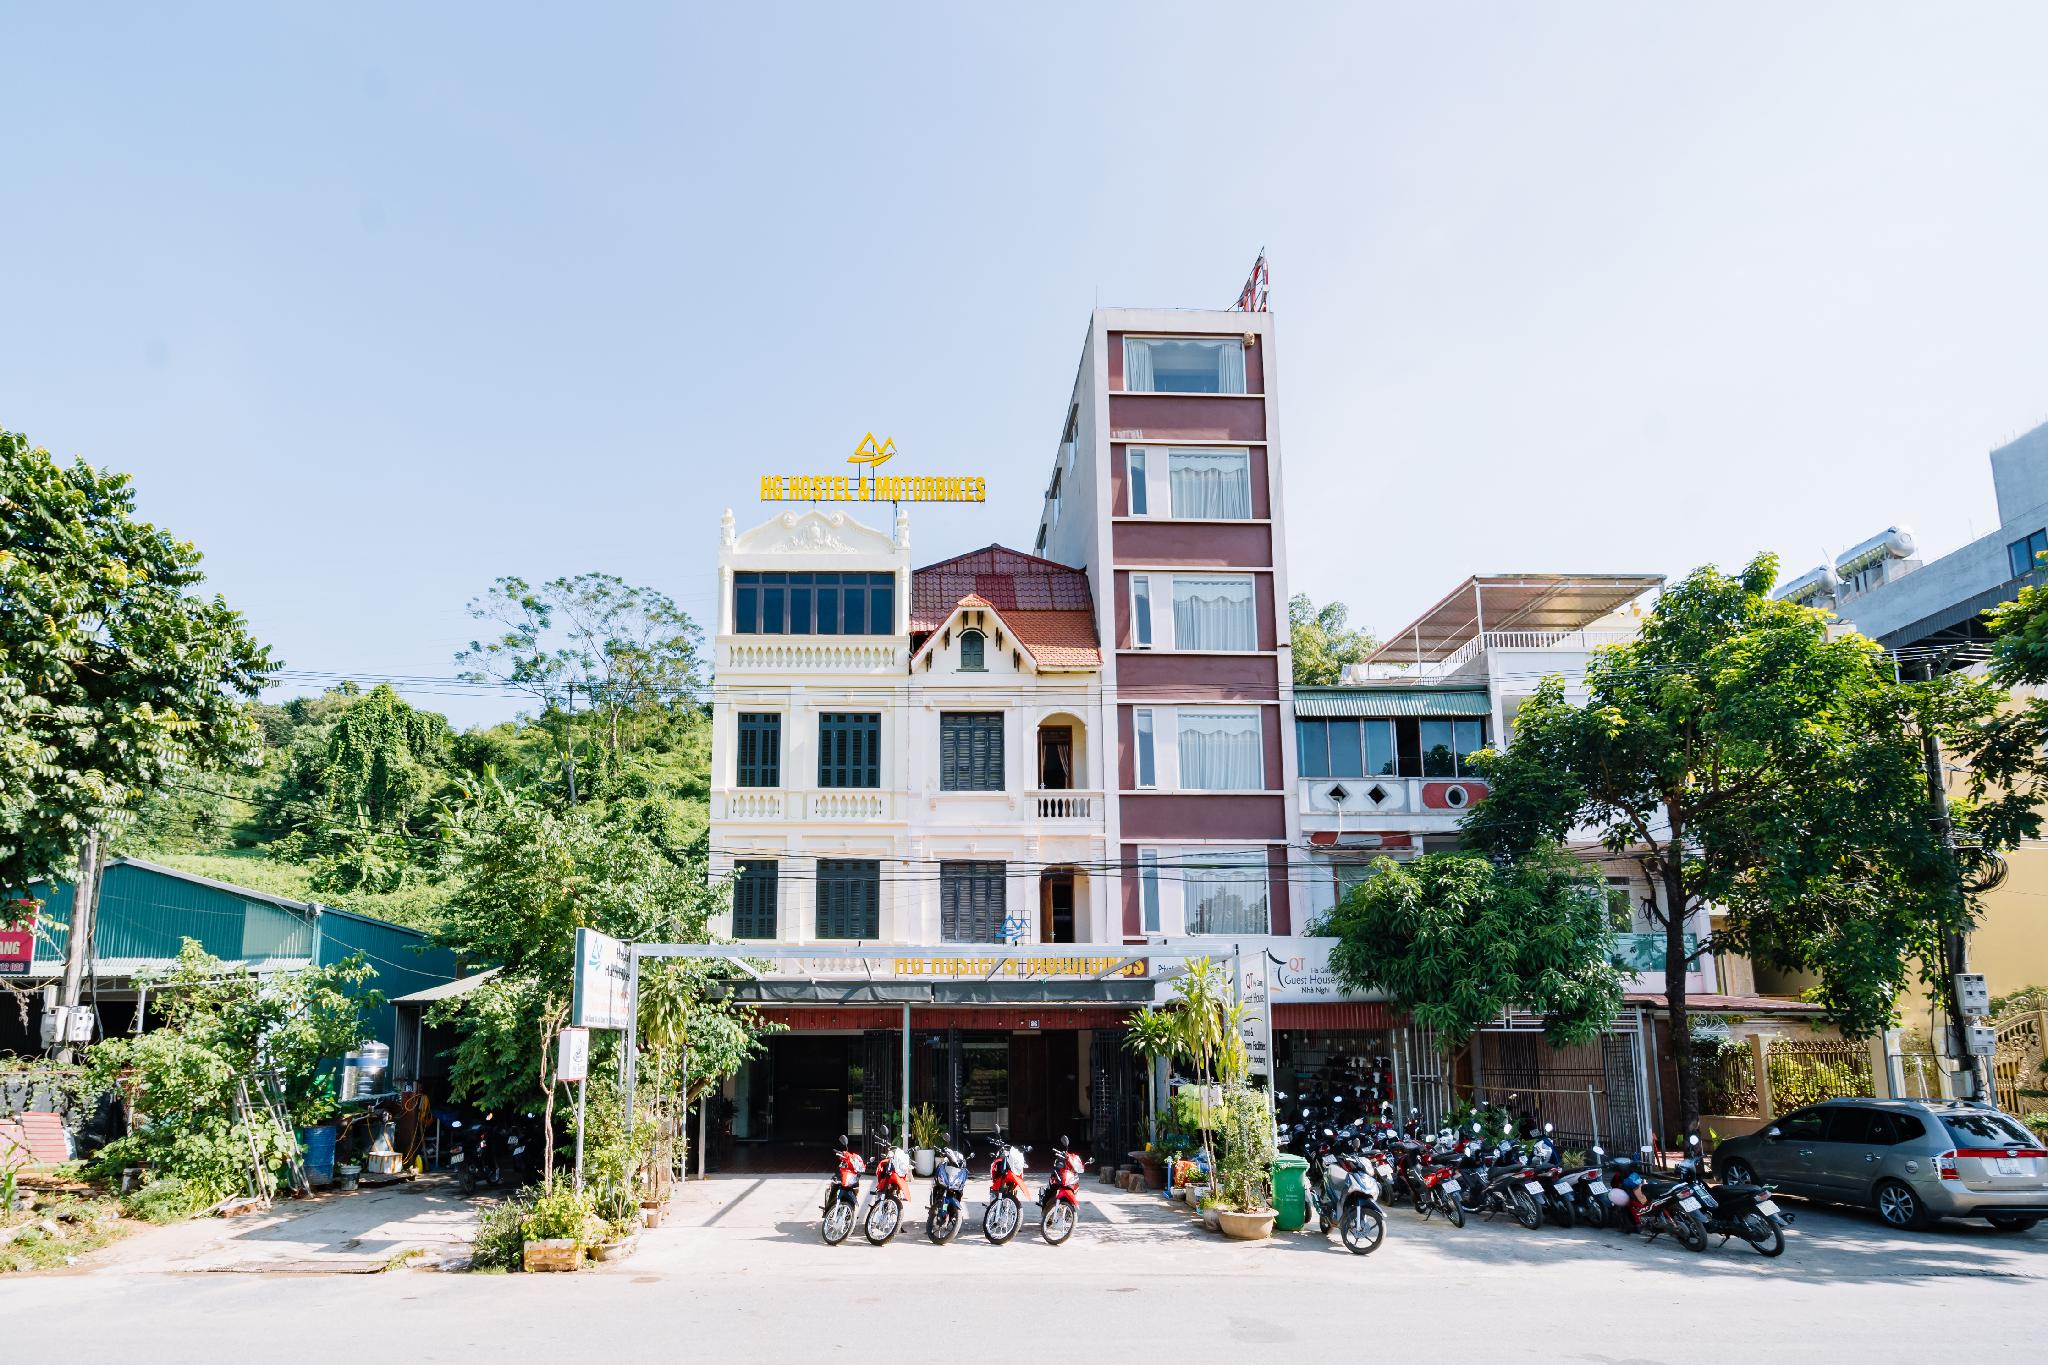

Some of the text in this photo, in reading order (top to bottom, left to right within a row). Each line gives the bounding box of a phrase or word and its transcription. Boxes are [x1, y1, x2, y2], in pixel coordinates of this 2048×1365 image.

[761, 475, 985, 502] HG HOSTEL & MOTORBIKES
[1289, 957, 1305, 972] QT
[1284, 974, 1307, 985] Guest
